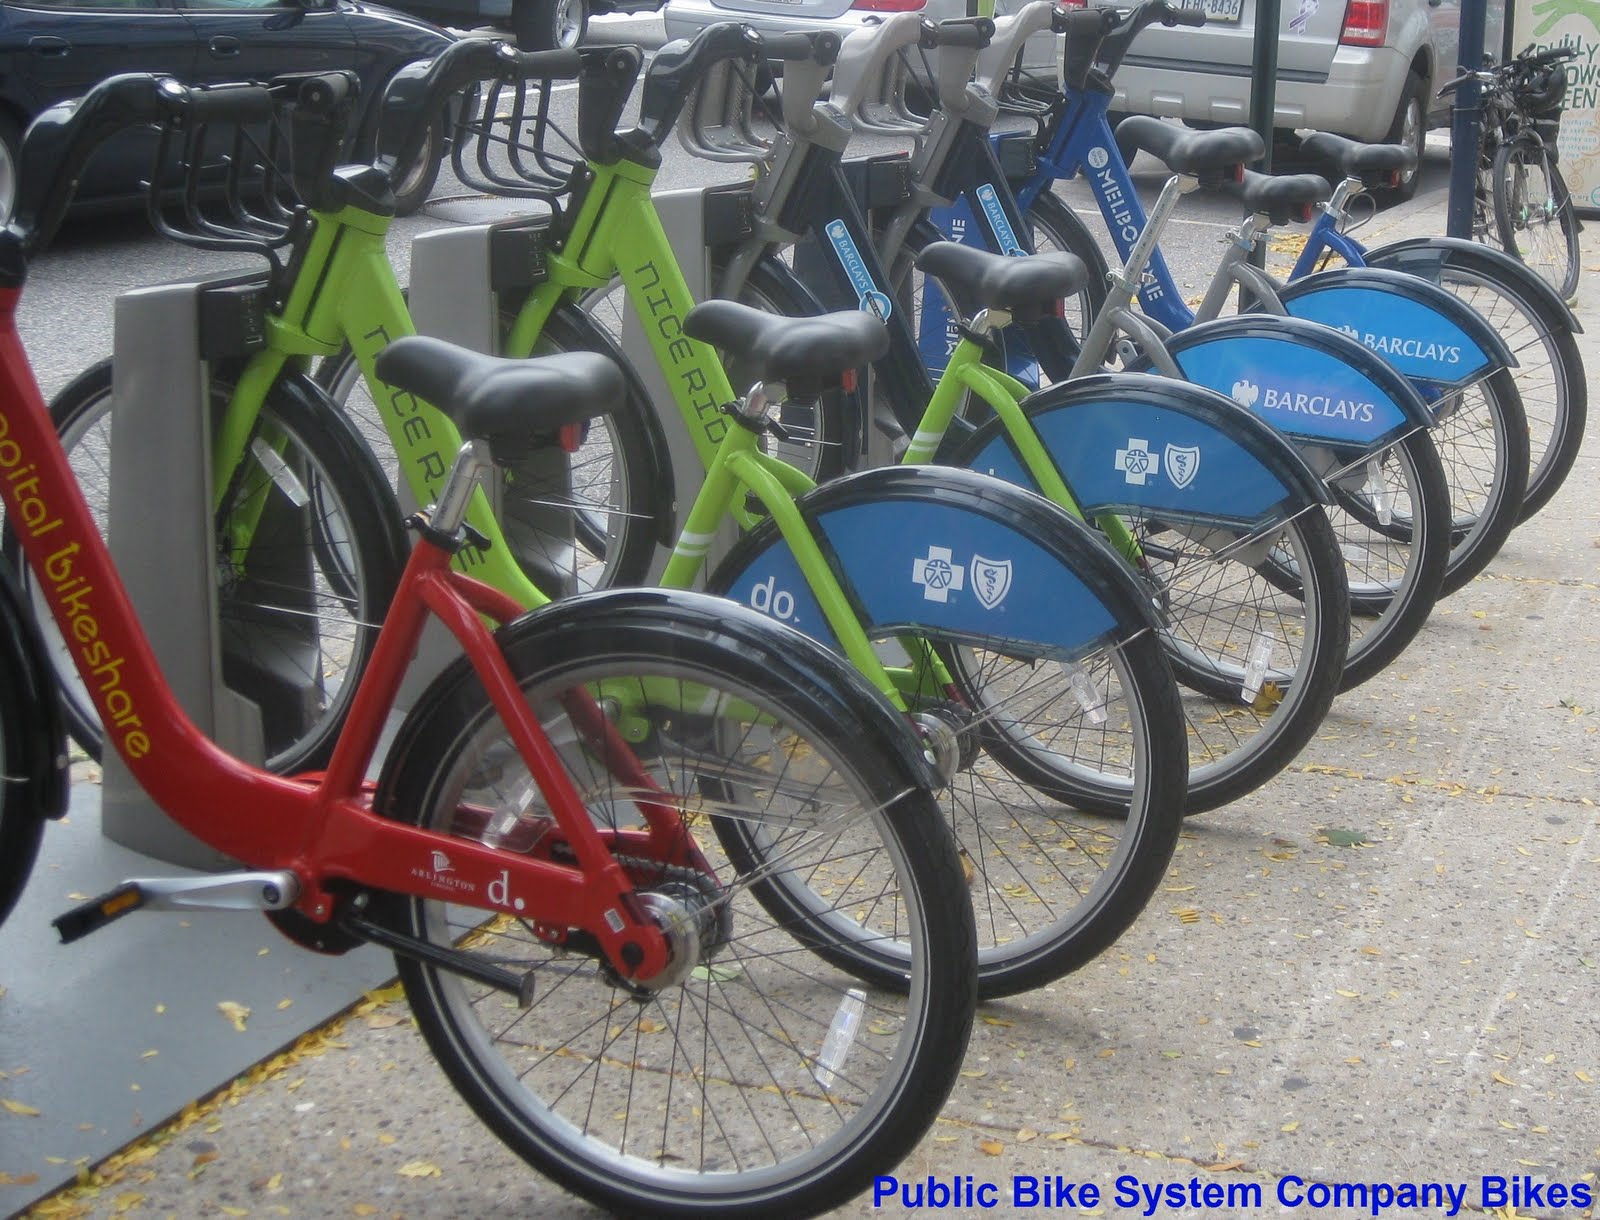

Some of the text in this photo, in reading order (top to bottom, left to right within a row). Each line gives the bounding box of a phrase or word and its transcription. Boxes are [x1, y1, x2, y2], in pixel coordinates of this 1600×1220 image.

[987, 202, 1013, 246] BARCLAYS
[838, 240, 869, 289] BARCLAYS
[1364, 333, 1461, 364] BARCLAYS
[681, 367, 730, 446] RID
[1263, 389, 1375, 423] BARCLAYS
[45, 542, 151, 759] bikeshare
[488, 870, 525, 910] d.
